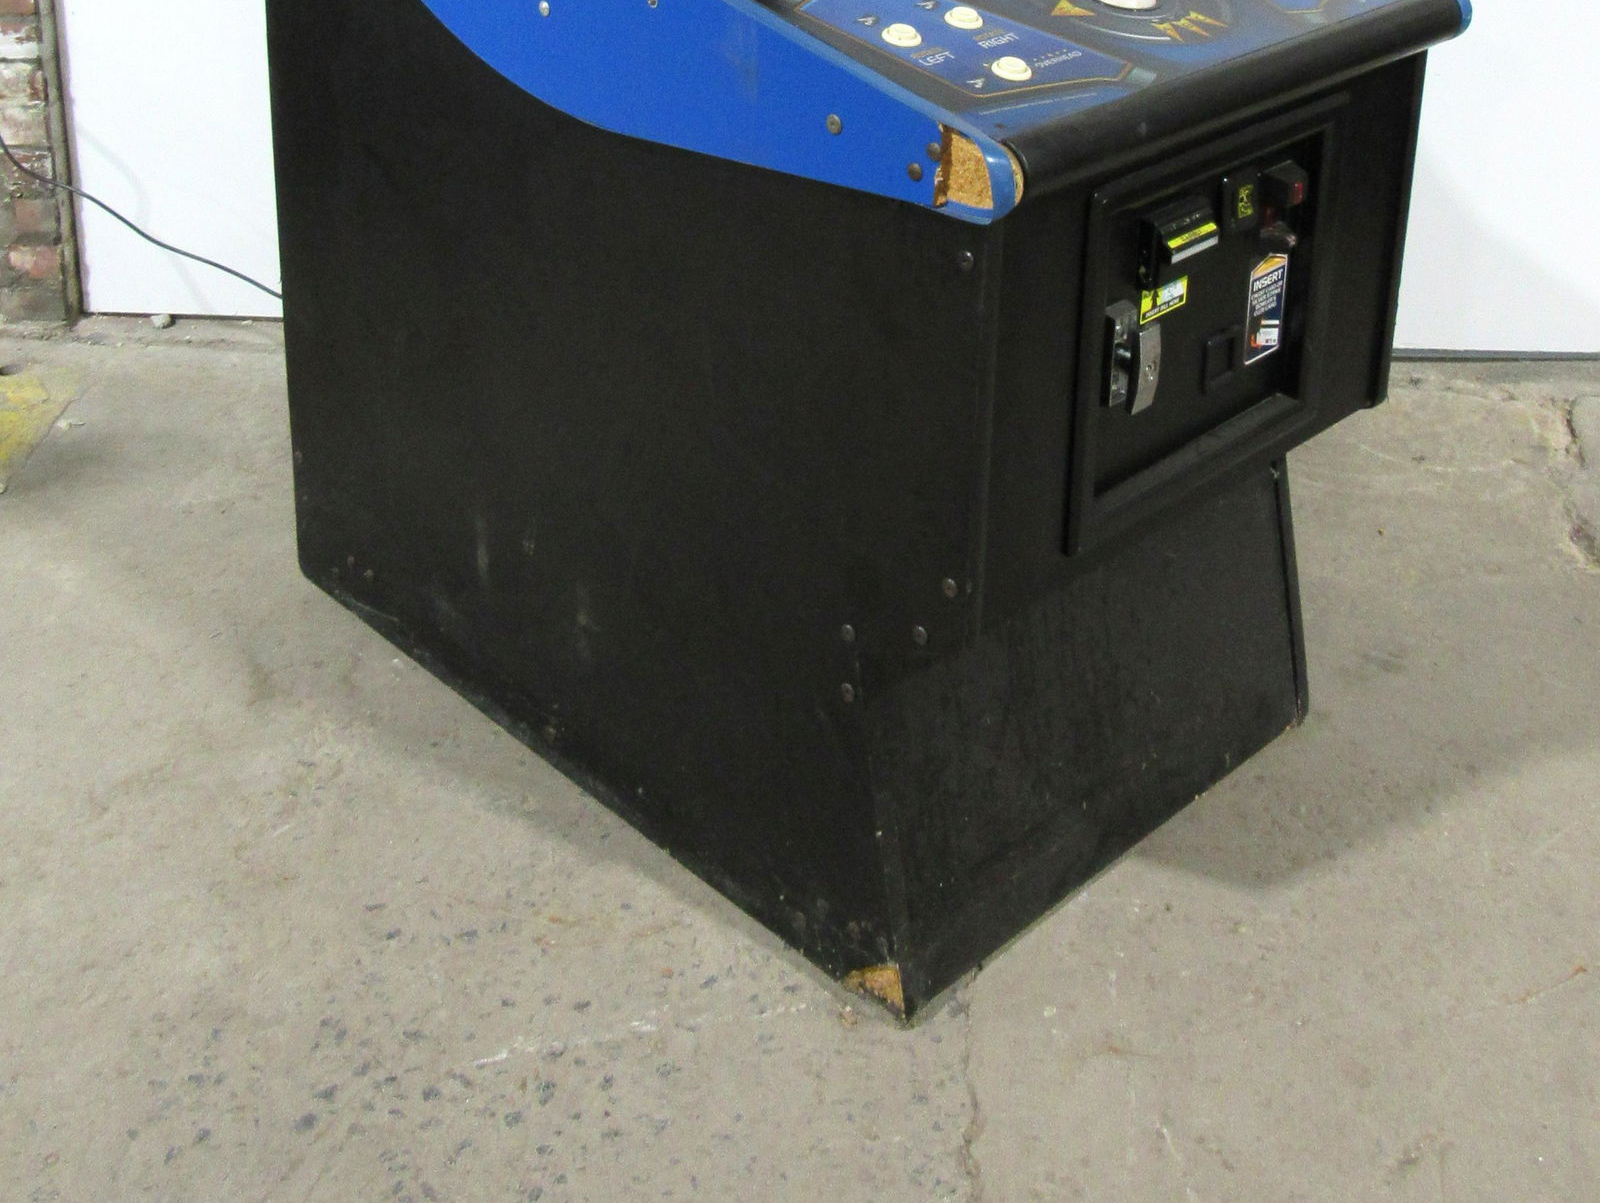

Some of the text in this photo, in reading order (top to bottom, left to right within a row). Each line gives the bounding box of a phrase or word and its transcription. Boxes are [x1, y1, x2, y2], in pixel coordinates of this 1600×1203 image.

[978, 32, 1020, 49] RIGHT
[919, 51, 955, 66] LEFT
[1253, 268, 1283, 292] INSERT
